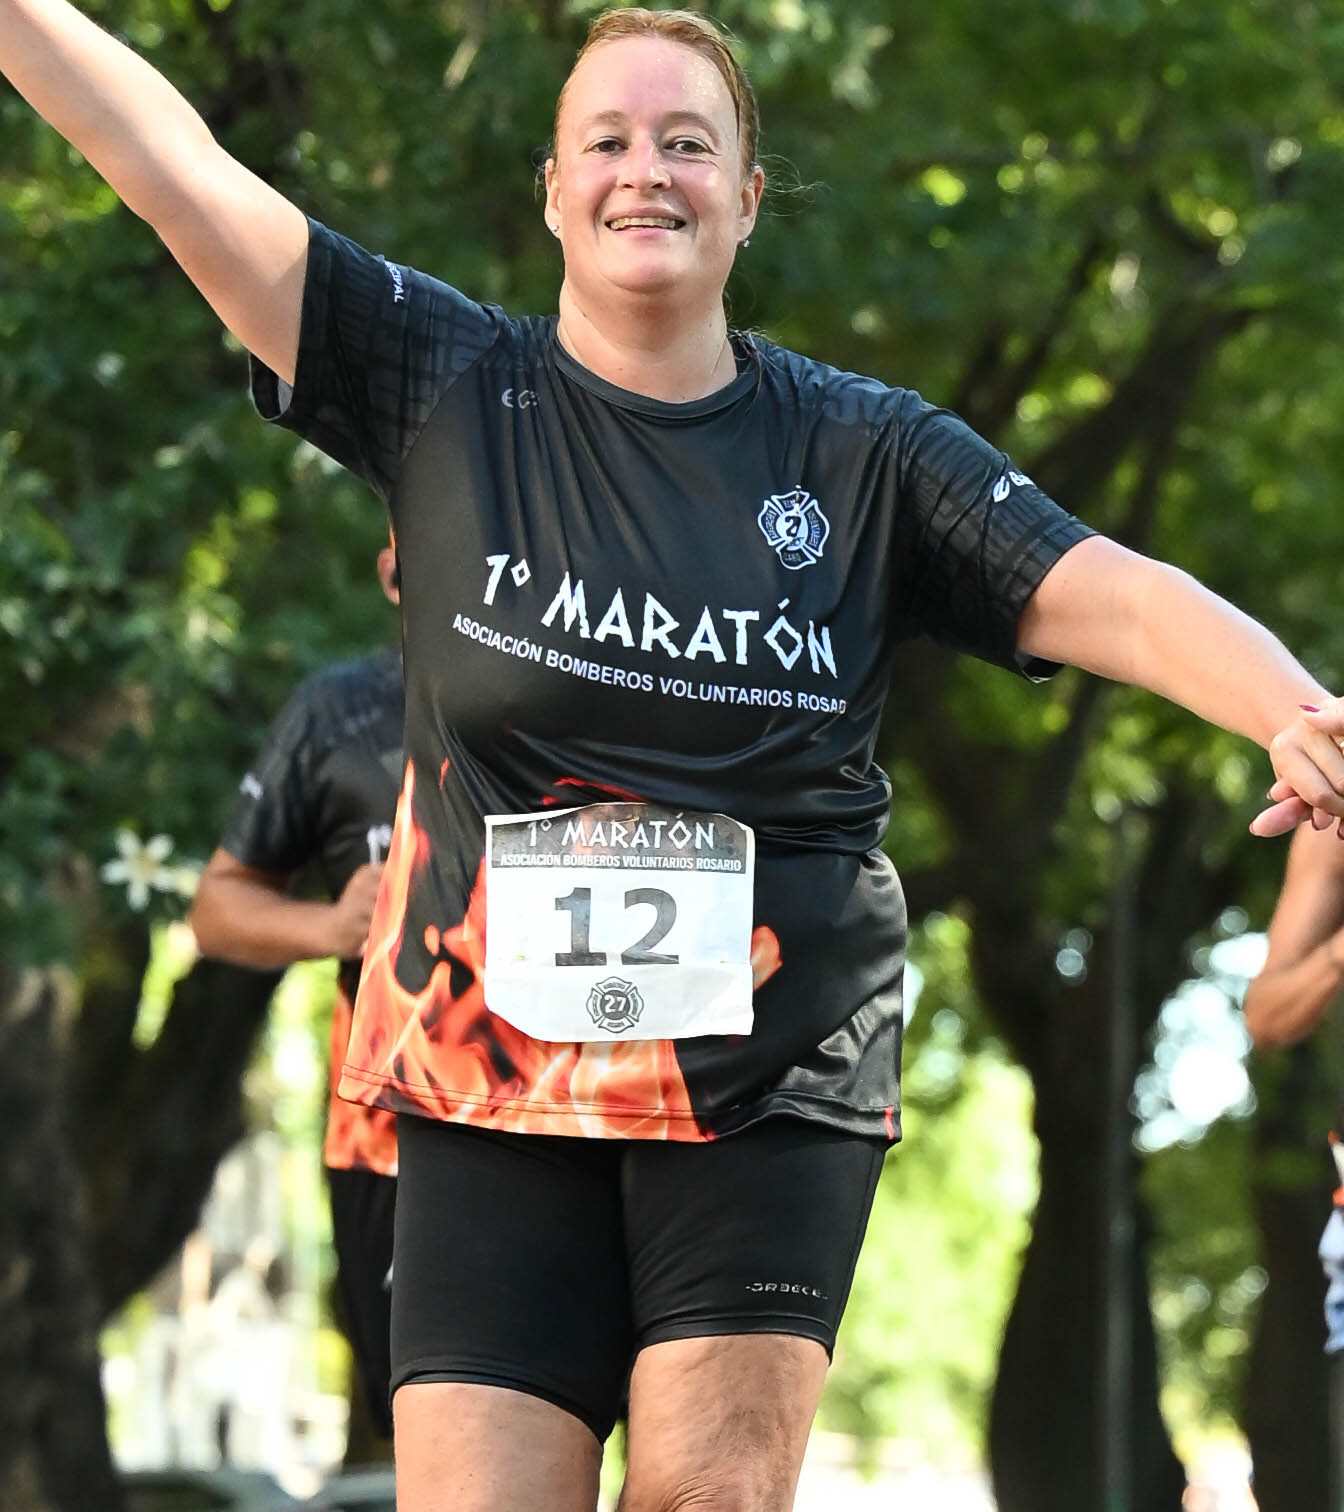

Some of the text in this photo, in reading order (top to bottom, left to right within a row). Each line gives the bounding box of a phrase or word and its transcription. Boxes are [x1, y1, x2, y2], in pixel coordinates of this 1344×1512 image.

[541, 570, 839, 681] MARATÓN
[452, 613, 543, 664] ASOCIACIÓN
[545, 649, 654, 693] BOMBEROS
[659, 676, 794, 709] VOLUNTARIOS
[560, 811, 715, 851] MARATÓN
[562, 854, 620, 868] BOMBEROS
[622, 855, 694, 869] VOLUNTARIOS
[696, 857, 742, 872] ROSARIO
[554, 887, 680, 967] 12
[603, 994, 627, 1014] 27
